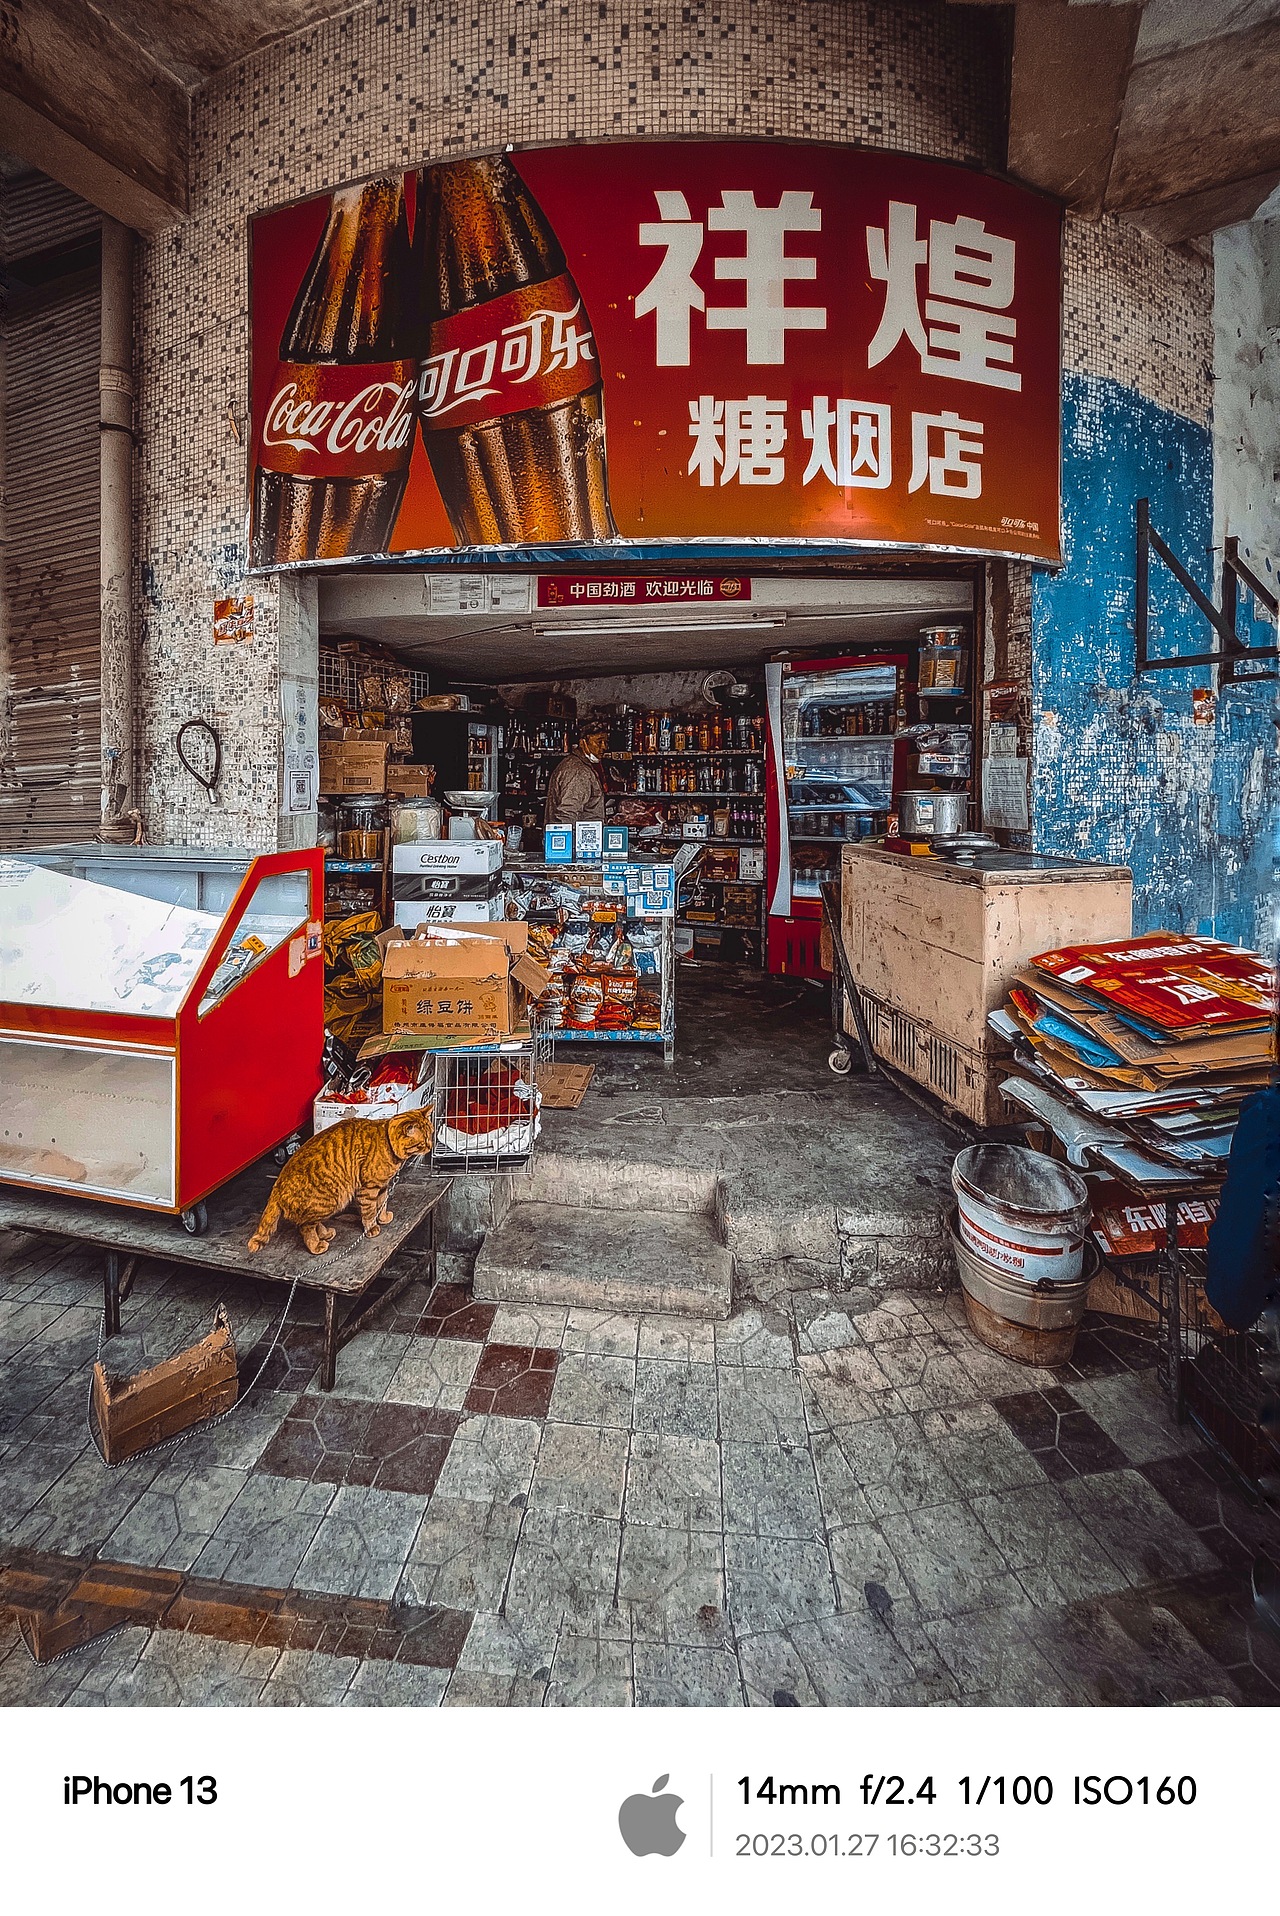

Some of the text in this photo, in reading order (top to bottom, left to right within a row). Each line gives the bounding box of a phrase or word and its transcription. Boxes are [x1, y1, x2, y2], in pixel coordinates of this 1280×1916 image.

[634, 190, 1022, 392] 祥煌
[418, 299, 595, 417] 可口可乐
[263, 379, 416, 454] Coca-Cola
[687, 395, 985, 499] 糖烟店
[569, 581, 636, 598] 中国劲酒
[645, 580, 714, 597] 欢迎光临
[416, 999, 473, 1015] 绿豆饼
[1121, 1199, 1220, 1232] 东鹏特
